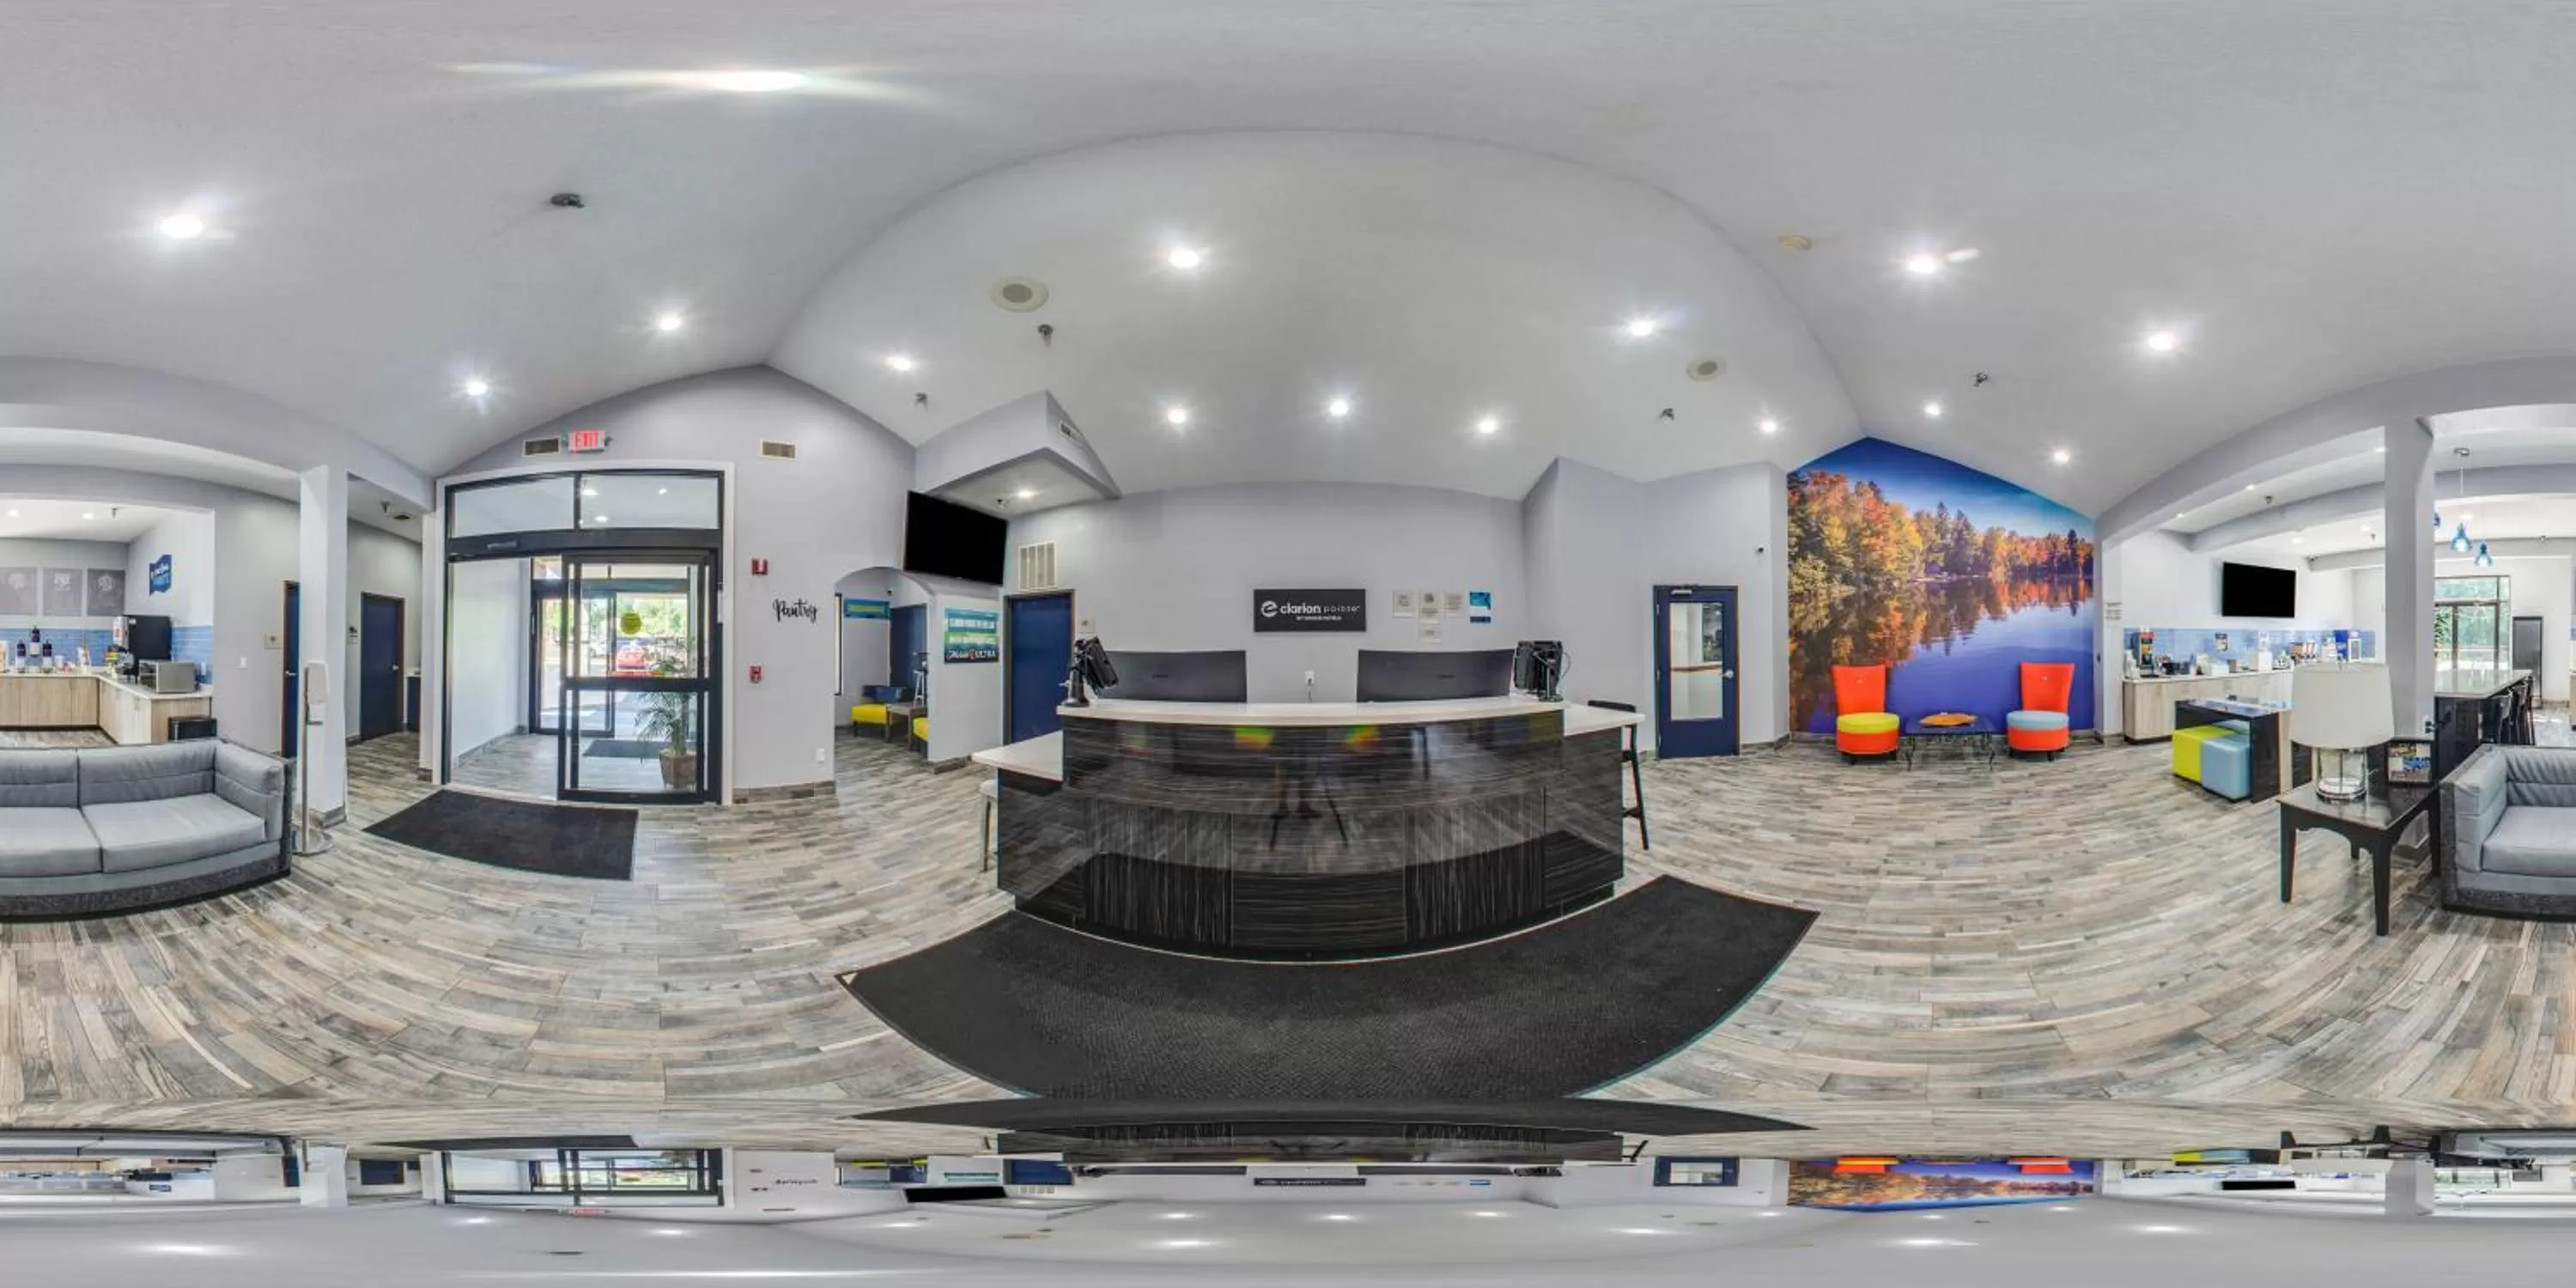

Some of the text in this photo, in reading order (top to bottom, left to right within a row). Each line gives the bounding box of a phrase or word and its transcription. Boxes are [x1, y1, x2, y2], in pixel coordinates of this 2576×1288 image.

[574, 432, 598, 447] EXIT
[772, 598, 817, 623] Pantry
[1279, 602, 1321, 614] clarion
